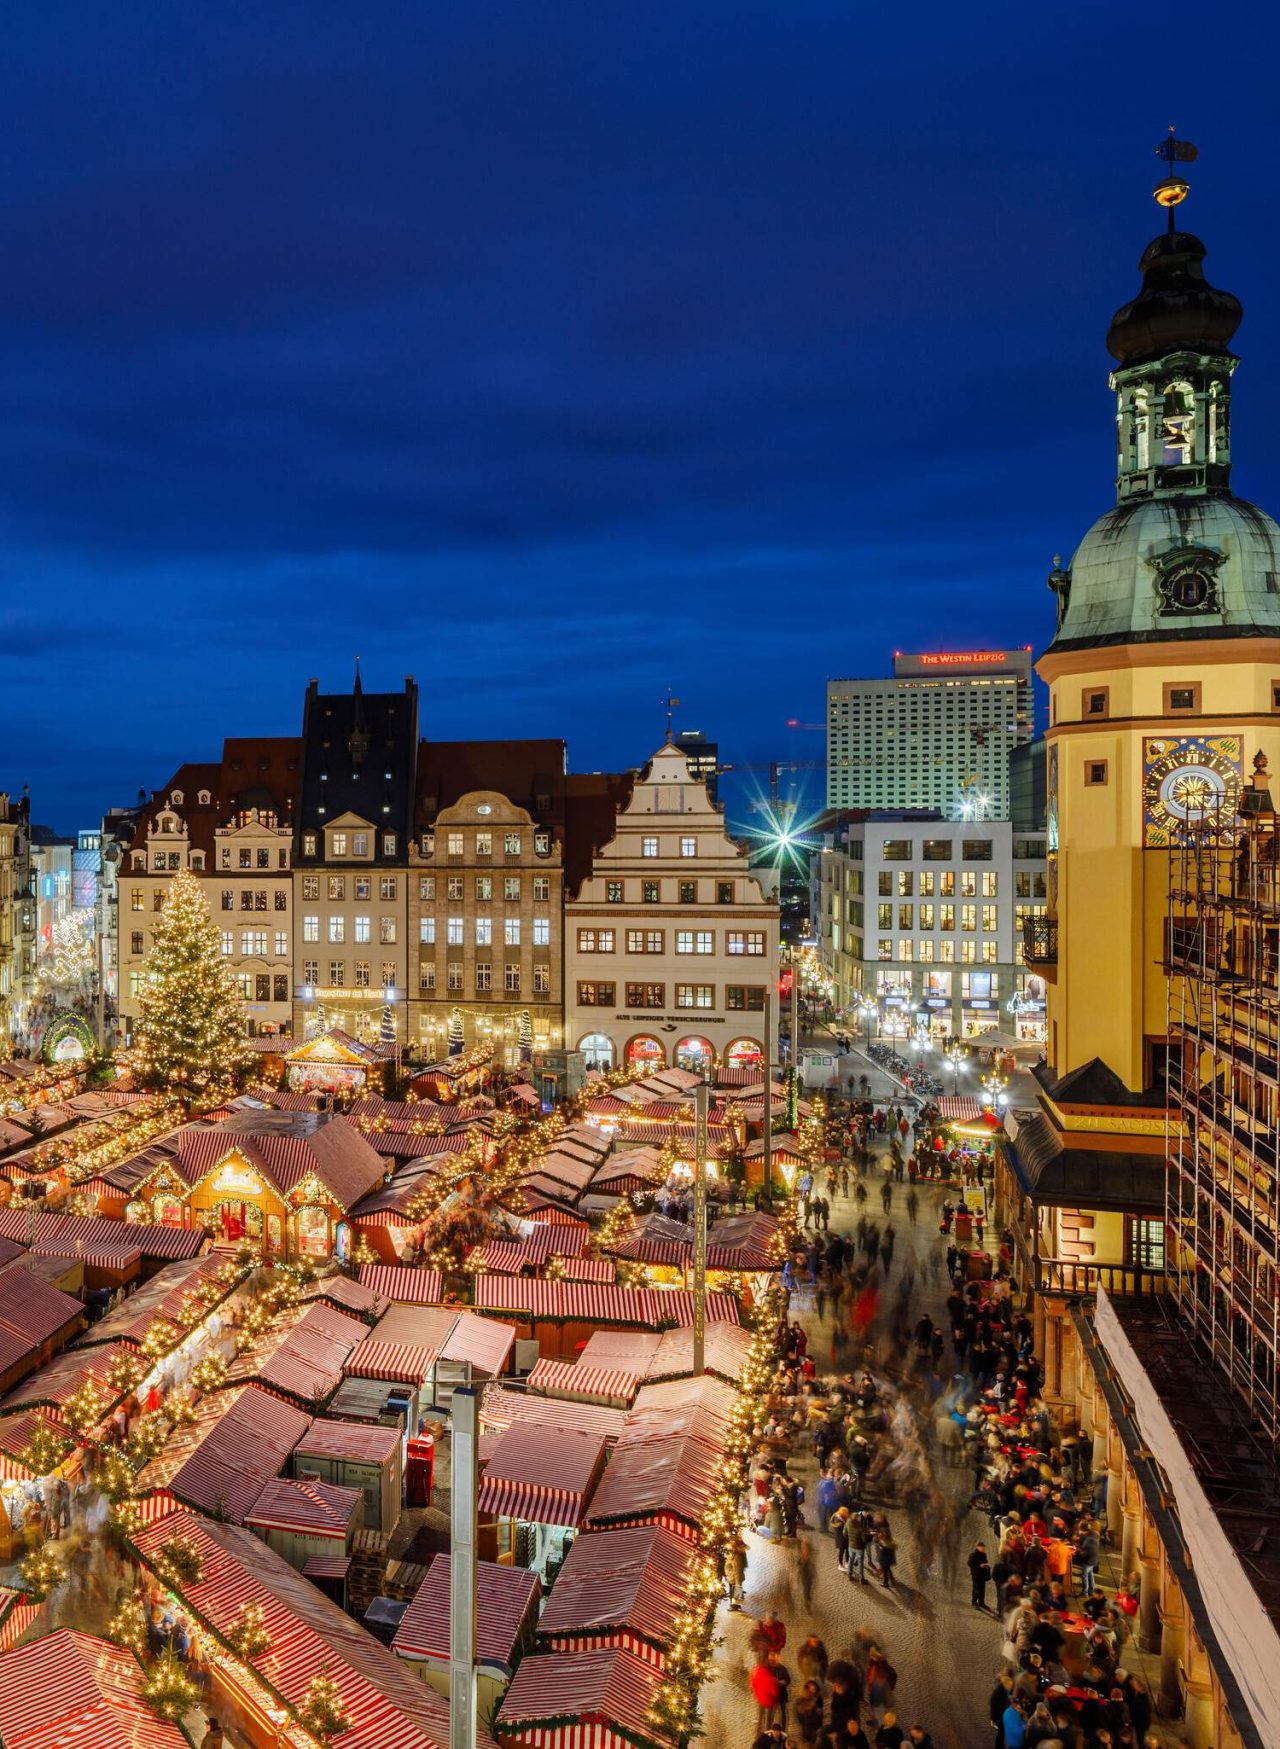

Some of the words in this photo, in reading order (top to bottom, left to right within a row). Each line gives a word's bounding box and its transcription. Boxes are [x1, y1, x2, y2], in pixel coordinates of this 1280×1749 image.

[922, 655, 939, 664] THE
[939, 655, 972, 663] WESTIN
[973, 653, 1005, 662] LEIPZIG
